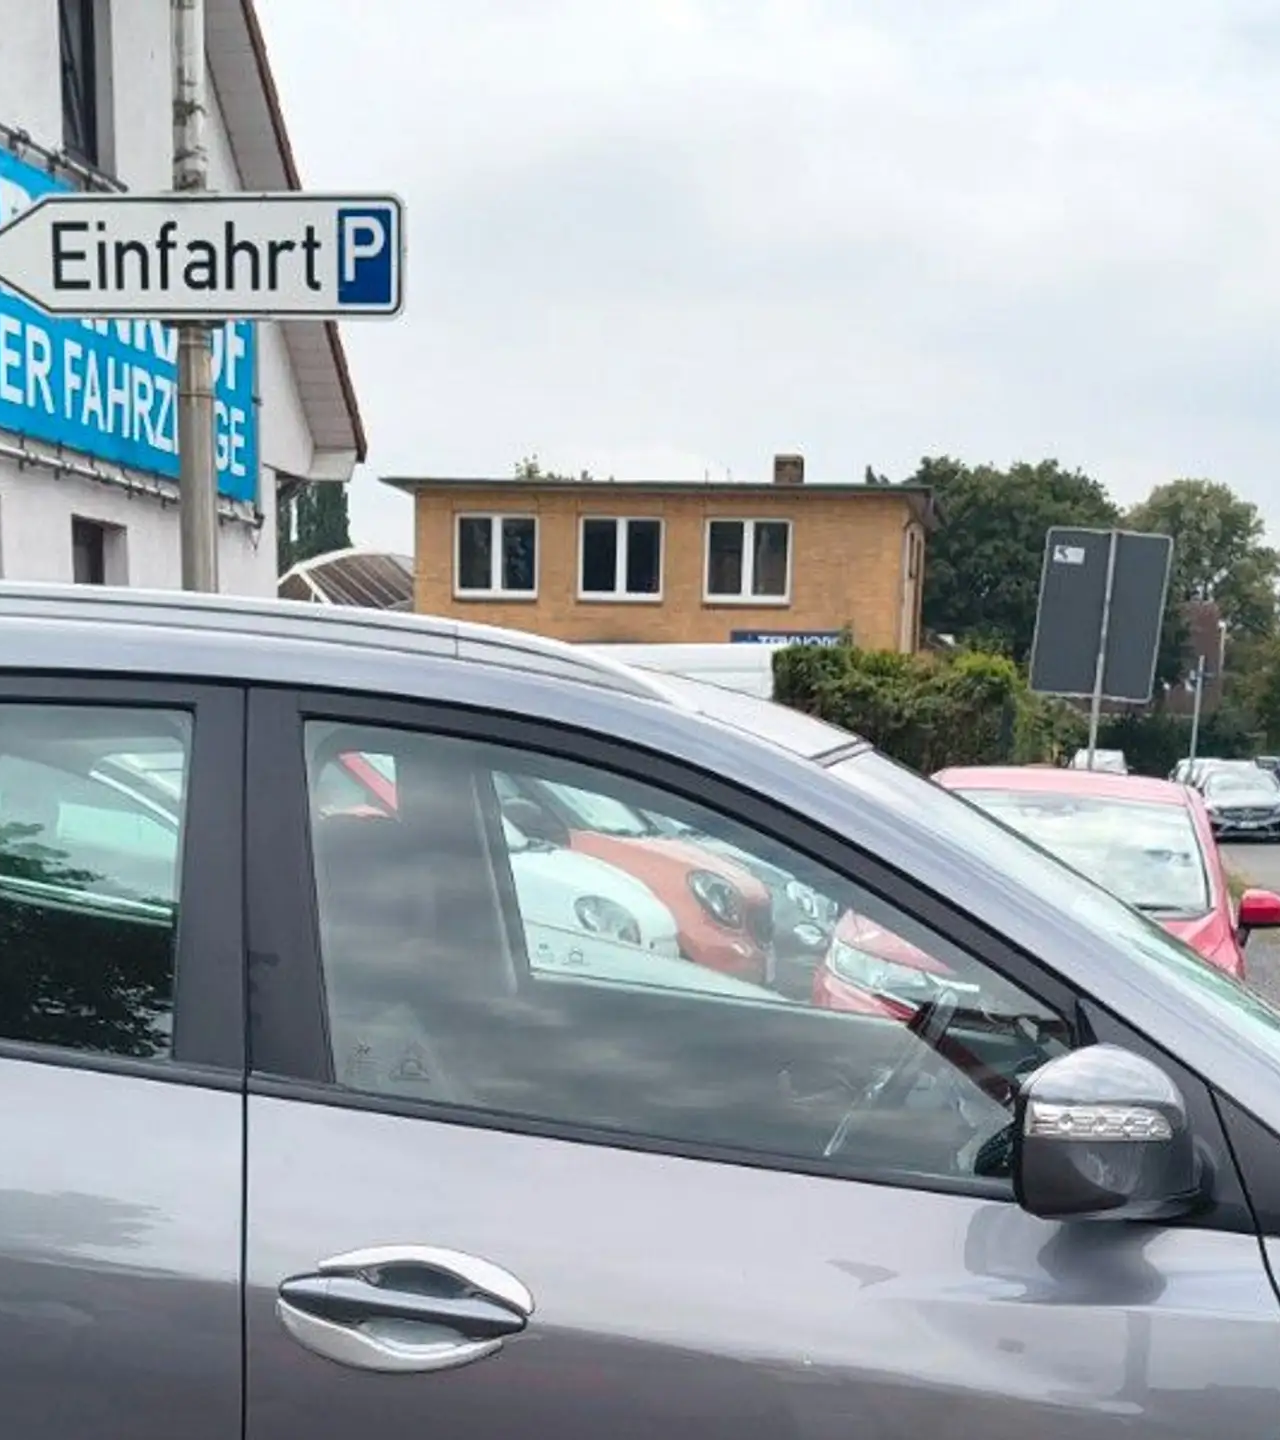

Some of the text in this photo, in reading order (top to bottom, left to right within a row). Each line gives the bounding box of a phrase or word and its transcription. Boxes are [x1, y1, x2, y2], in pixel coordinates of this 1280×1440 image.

[51, 215, 385, 291] Einfahrt P
[64, 338, 246, 477] FAHRZGE
